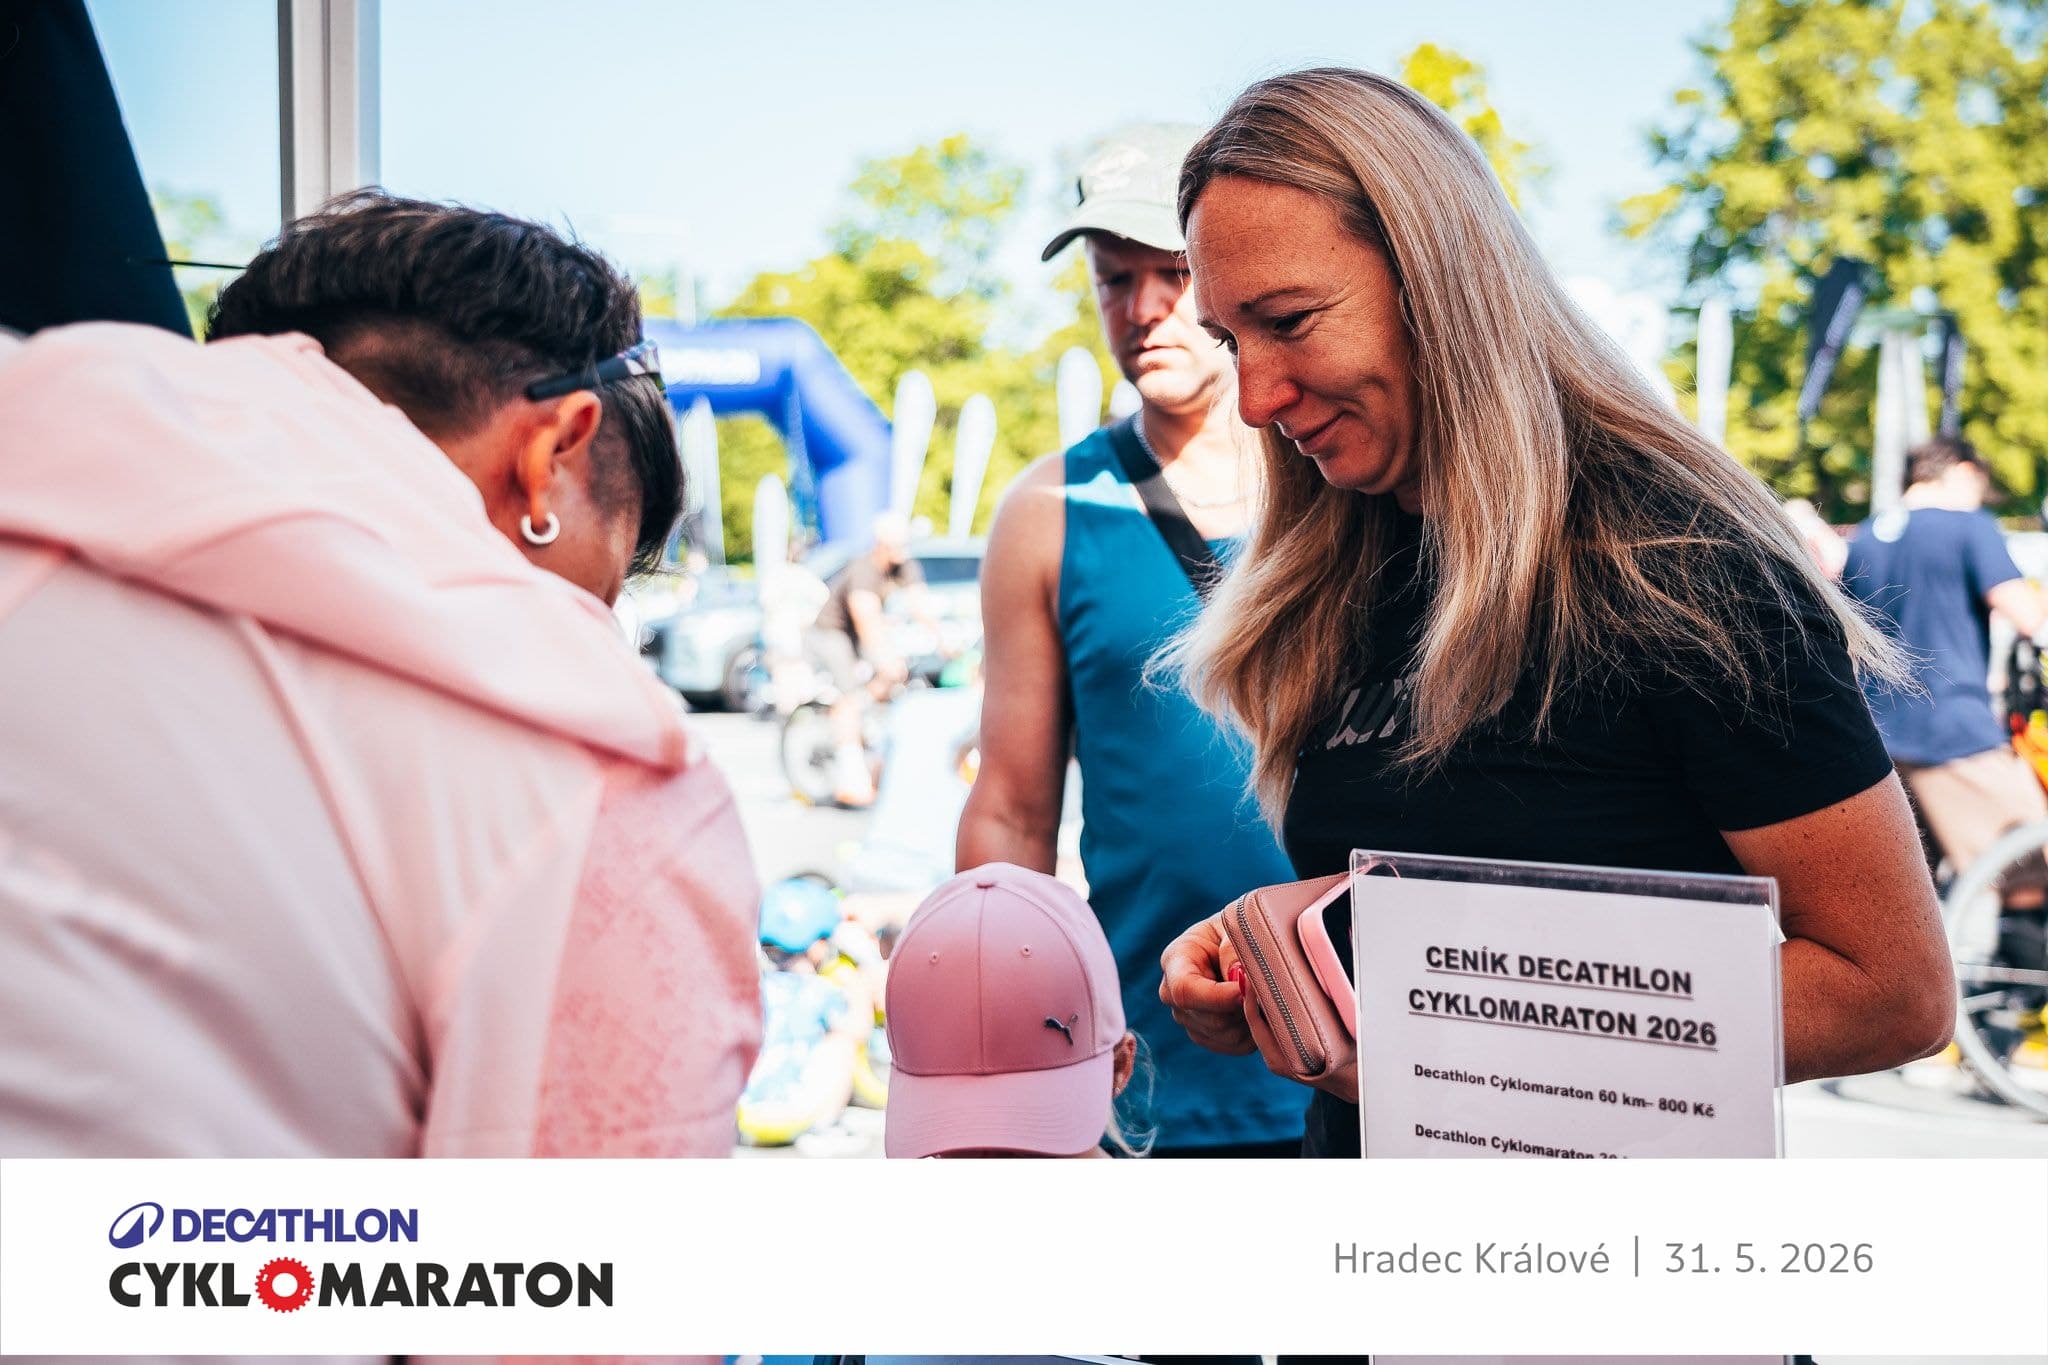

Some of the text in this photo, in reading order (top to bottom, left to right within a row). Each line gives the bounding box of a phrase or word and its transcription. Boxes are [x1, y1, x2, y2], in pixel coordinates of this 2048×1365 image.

[1426, 945, 1693, 994] CENÍK DECATHLON
[1408, 988, 1718, 1046] CYKLOMARATON 2026
[1414, 1064, 1486, 1086] Decathlon
[1490, 1074, 1594, 1101] Cyklomaraton
[1598, 1088, 1618, 1104] 60
[1658, 1097, 1689, 1114] 800
[1692, 1101, 1715, 1118] Kč
[1414, 1123, 1487, 1147] Decathlon
